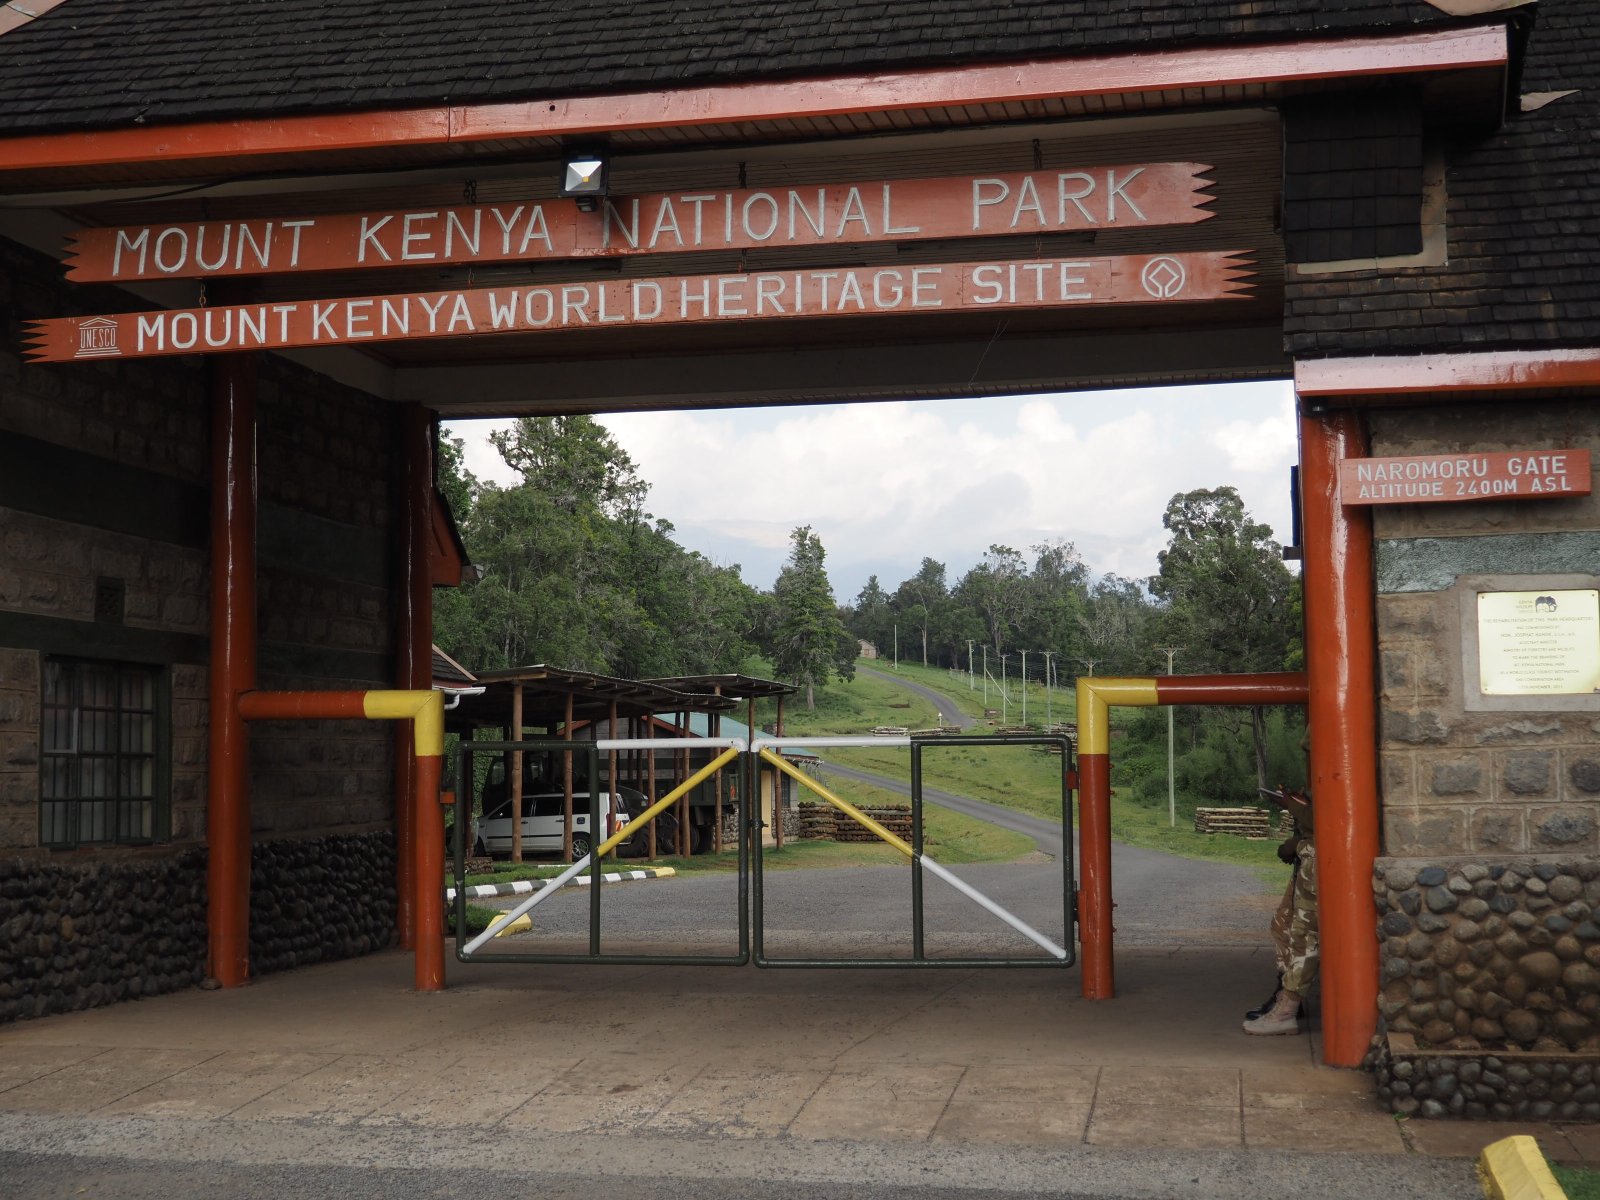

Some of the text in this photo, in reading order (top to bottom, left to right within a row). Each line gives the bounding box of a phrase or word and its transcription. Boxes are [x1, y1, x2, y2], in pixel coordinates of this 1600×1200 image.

[112, 167, 1146, 277] MOUNT KENYA NATIONAL PARK
[137, 261, 1092, 353] MOUNT KENYA WORLD HERITAGE SITE
[80, 328, 116, 349] UNESCO
[1357, 455, 1567, 482] NAROMORU GATE
[1359, 481, 1444, 499] ALTITUDE
[1456, 478, 1517, 496] 2400M
